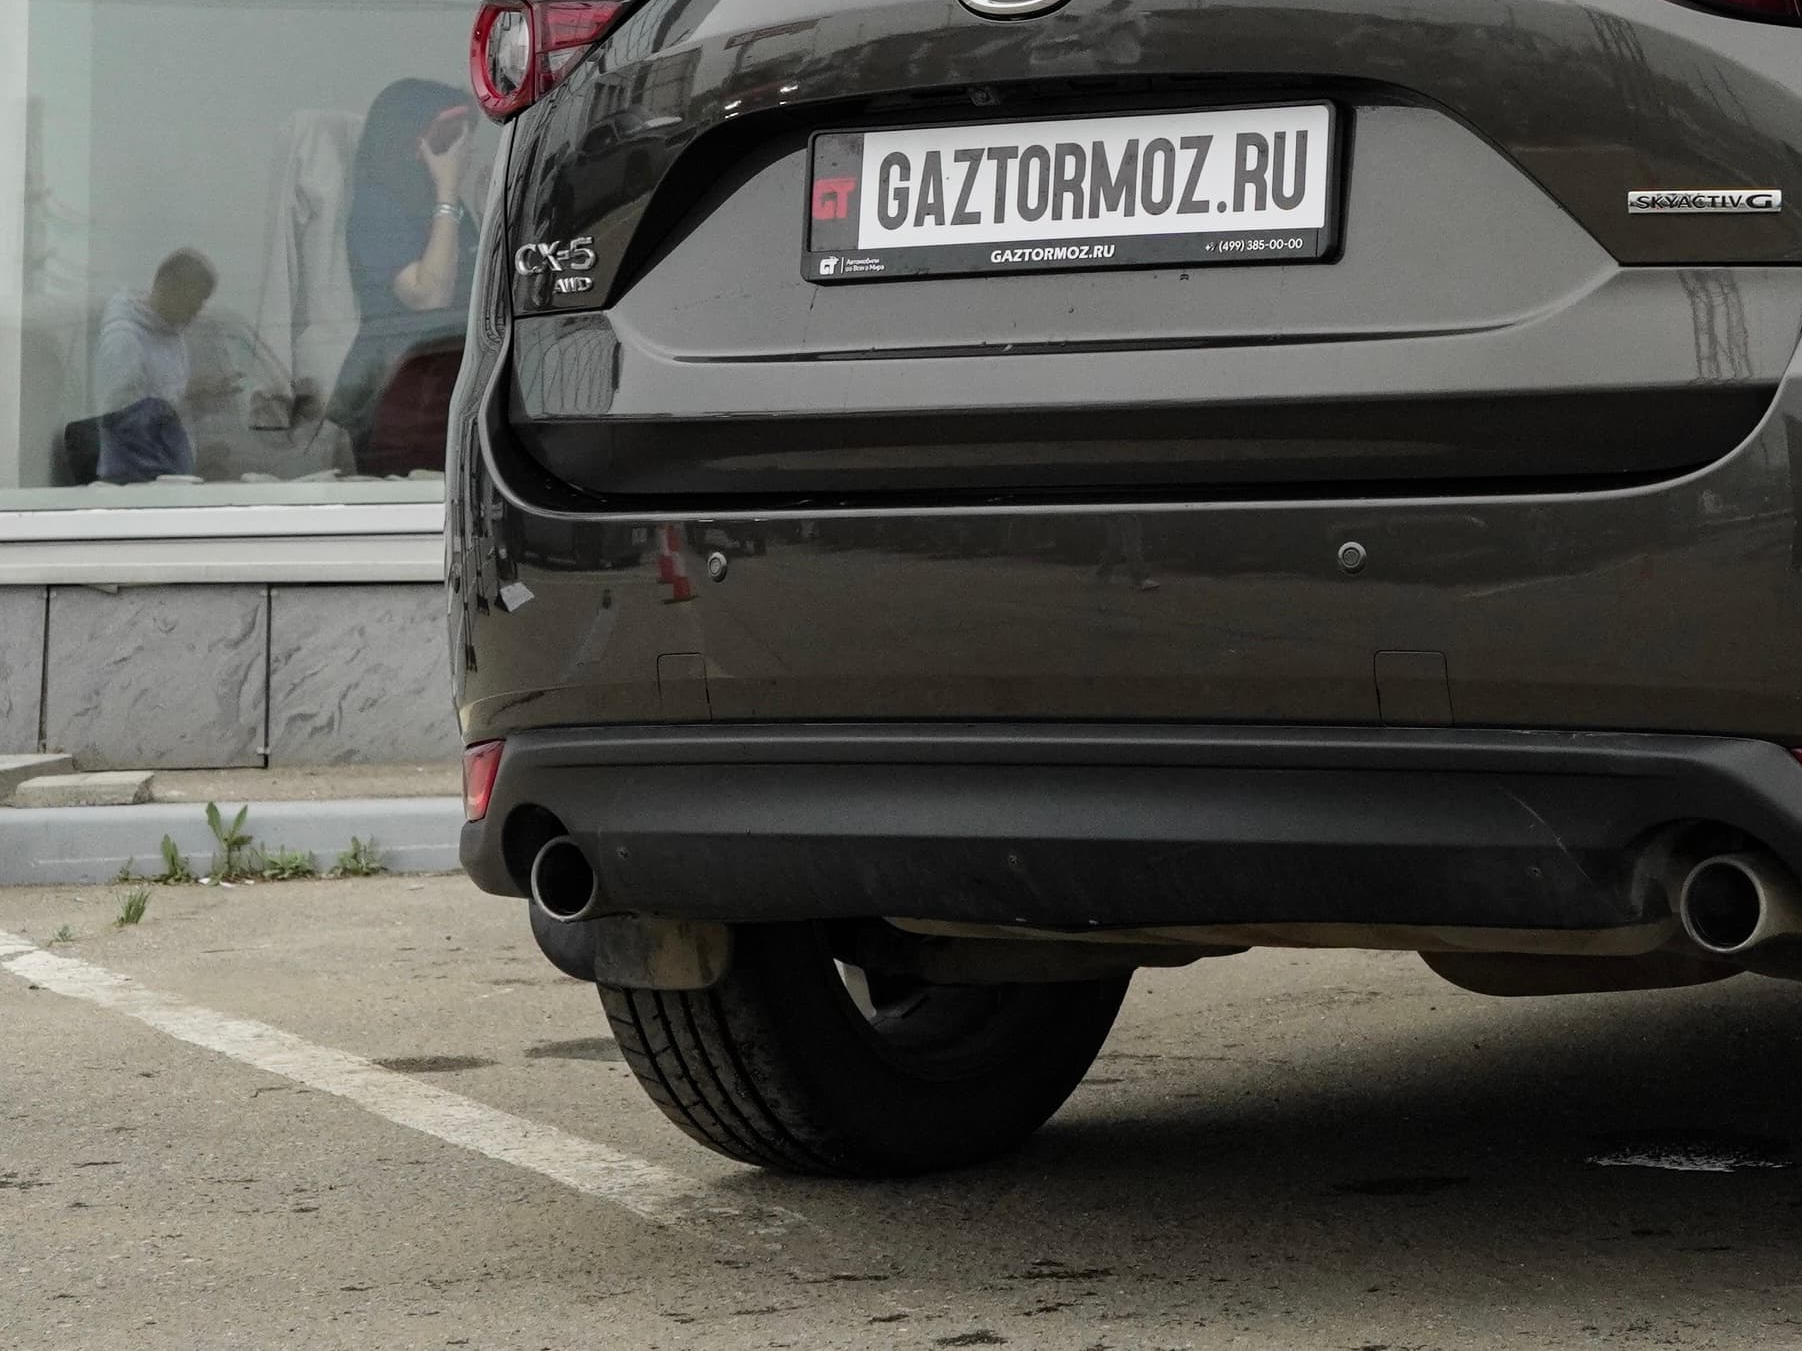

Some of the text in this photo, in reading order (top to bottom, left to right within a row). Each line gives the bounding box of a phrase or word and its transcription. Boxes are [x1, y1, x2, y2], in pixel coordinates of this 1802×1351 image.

[877, 130, 1309, 231] GAZTORMOZ.RU
[990, 244, 1116, 263] GAZTORMOZ.RU
[1218, 240, 1245, 253] (499)
[1246, 238, 1303, 251] 385-00-00
[515, 236, 597, 275] CX-5
[553, 276, 593, 294] AWD
